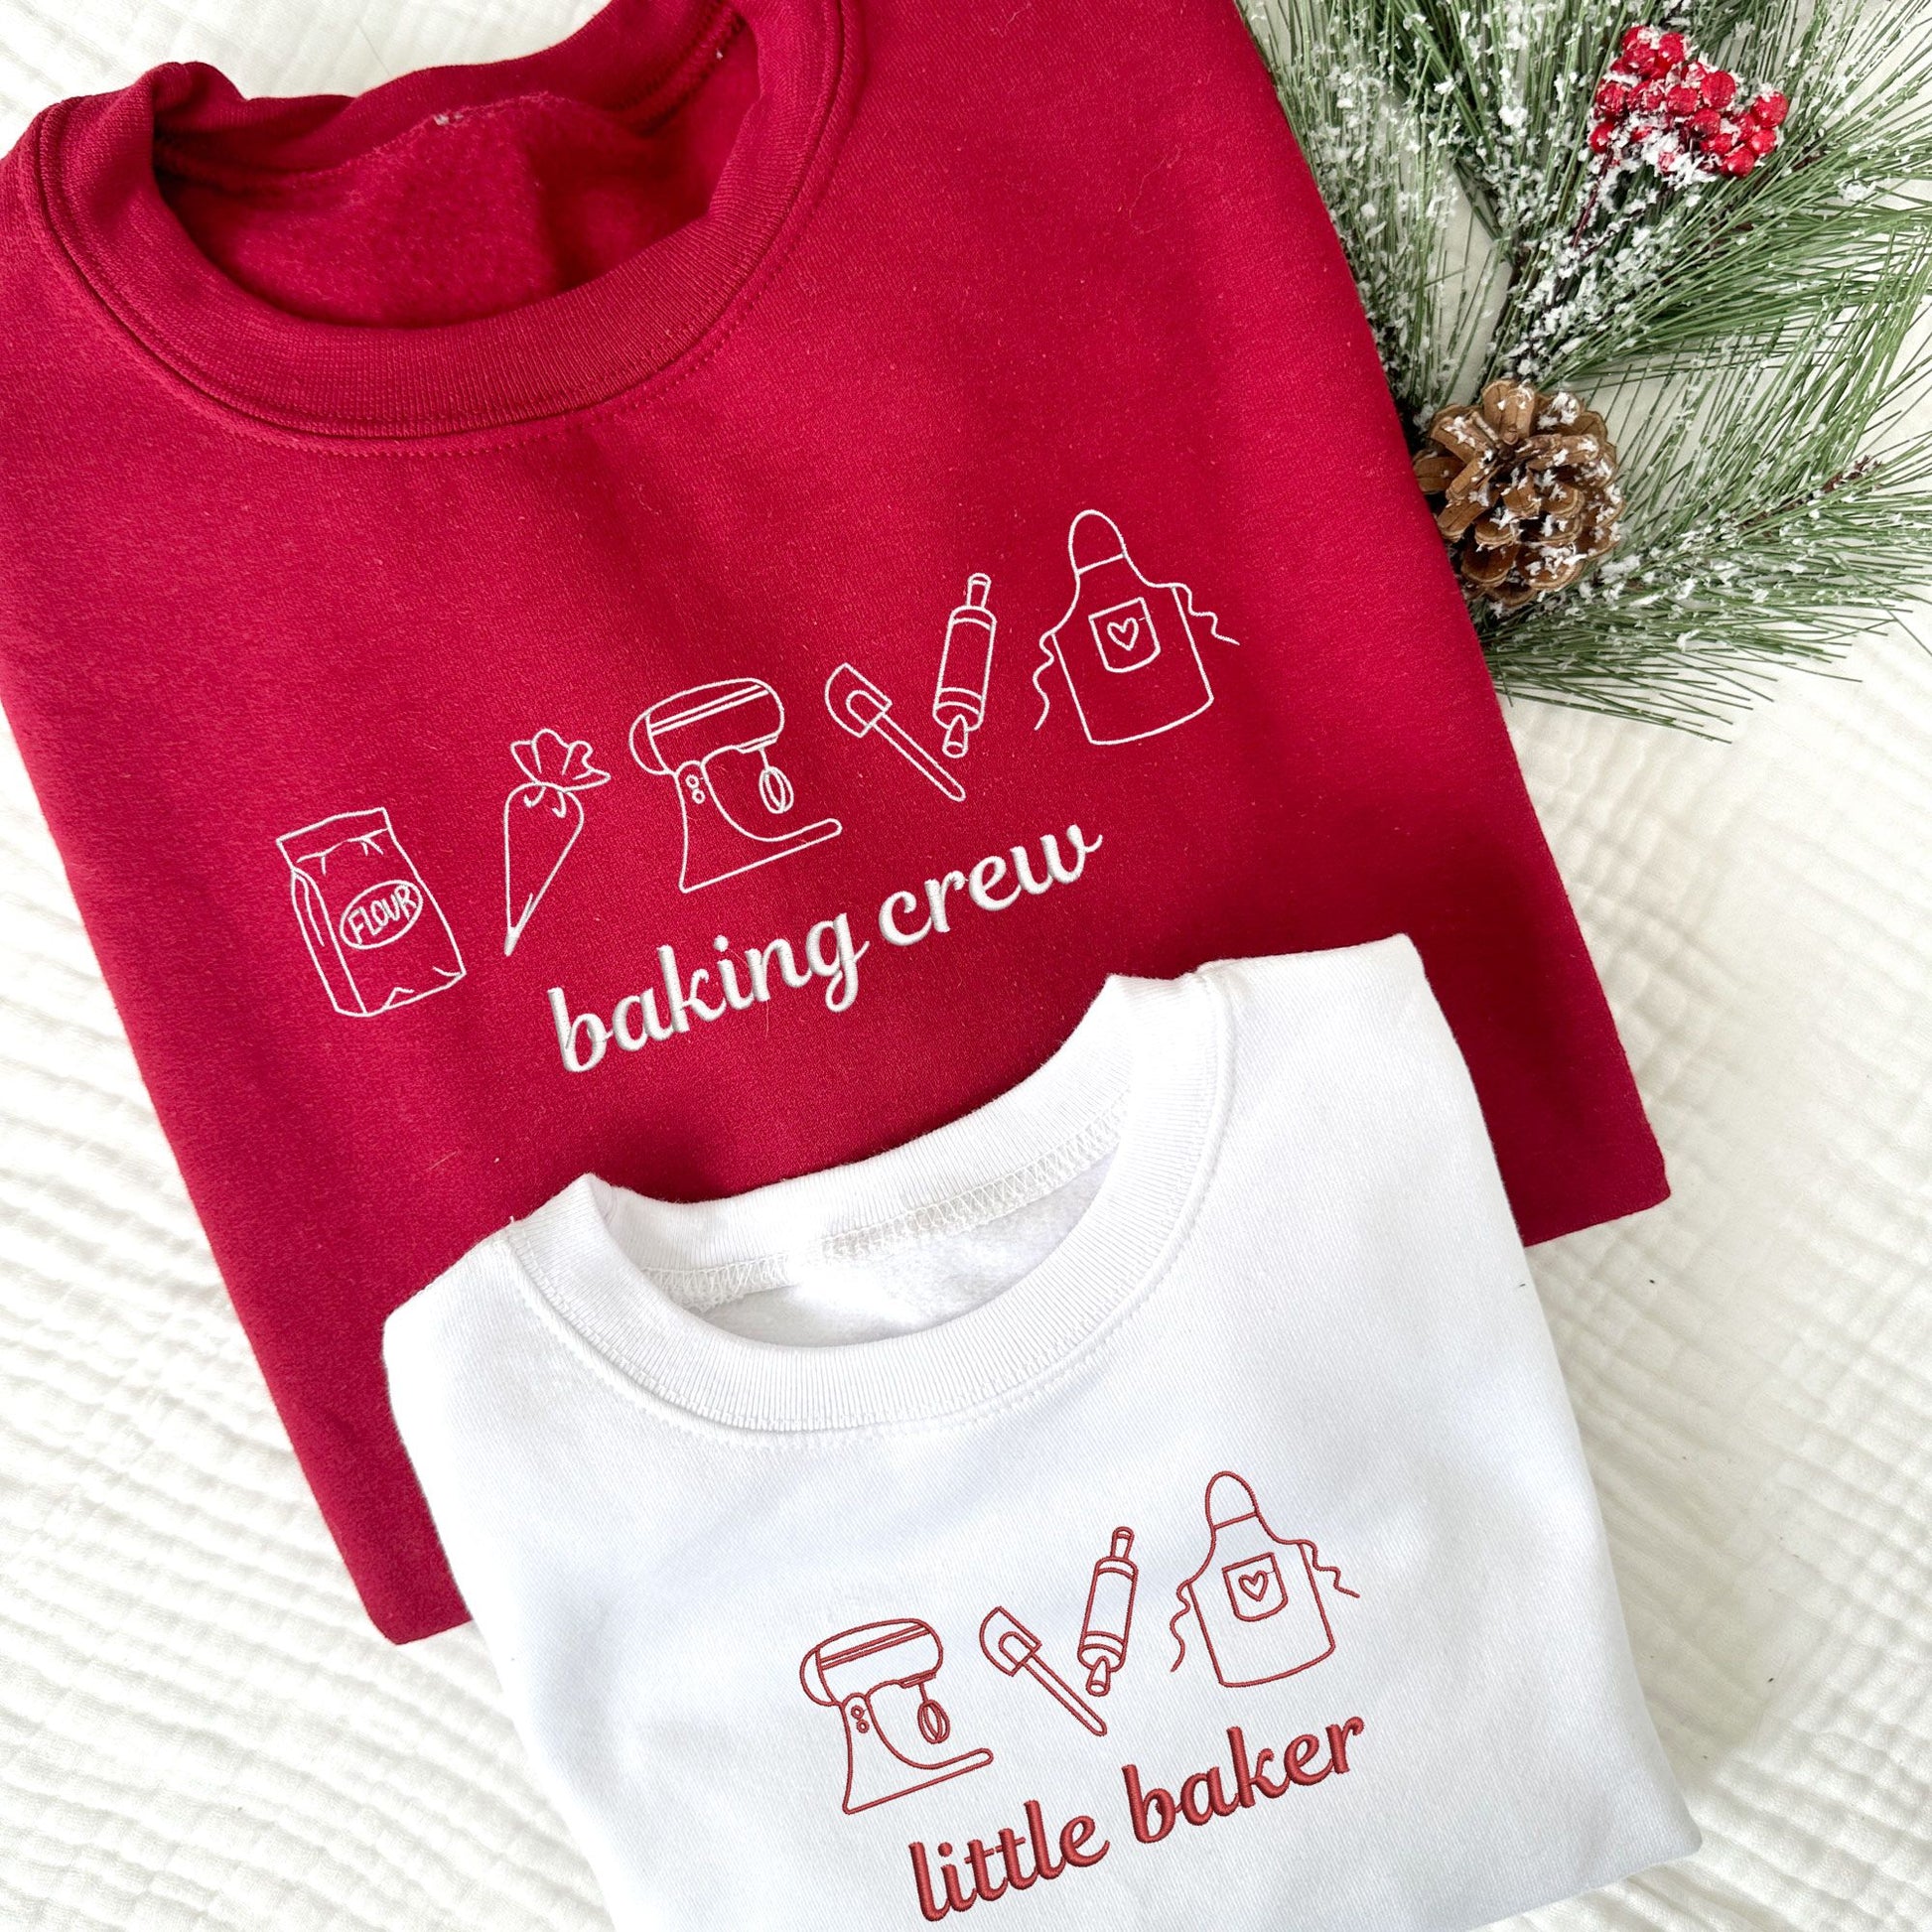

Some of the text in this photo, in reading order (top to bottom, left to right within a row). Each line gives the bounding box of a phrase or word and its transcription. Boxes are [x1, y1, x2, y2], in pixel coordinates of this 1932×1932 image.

[347, 885, 418, 944] FLOUR
[547, 824, 1103, 1072] baking crew
[909, 1717, 1365, 1922] little baker
